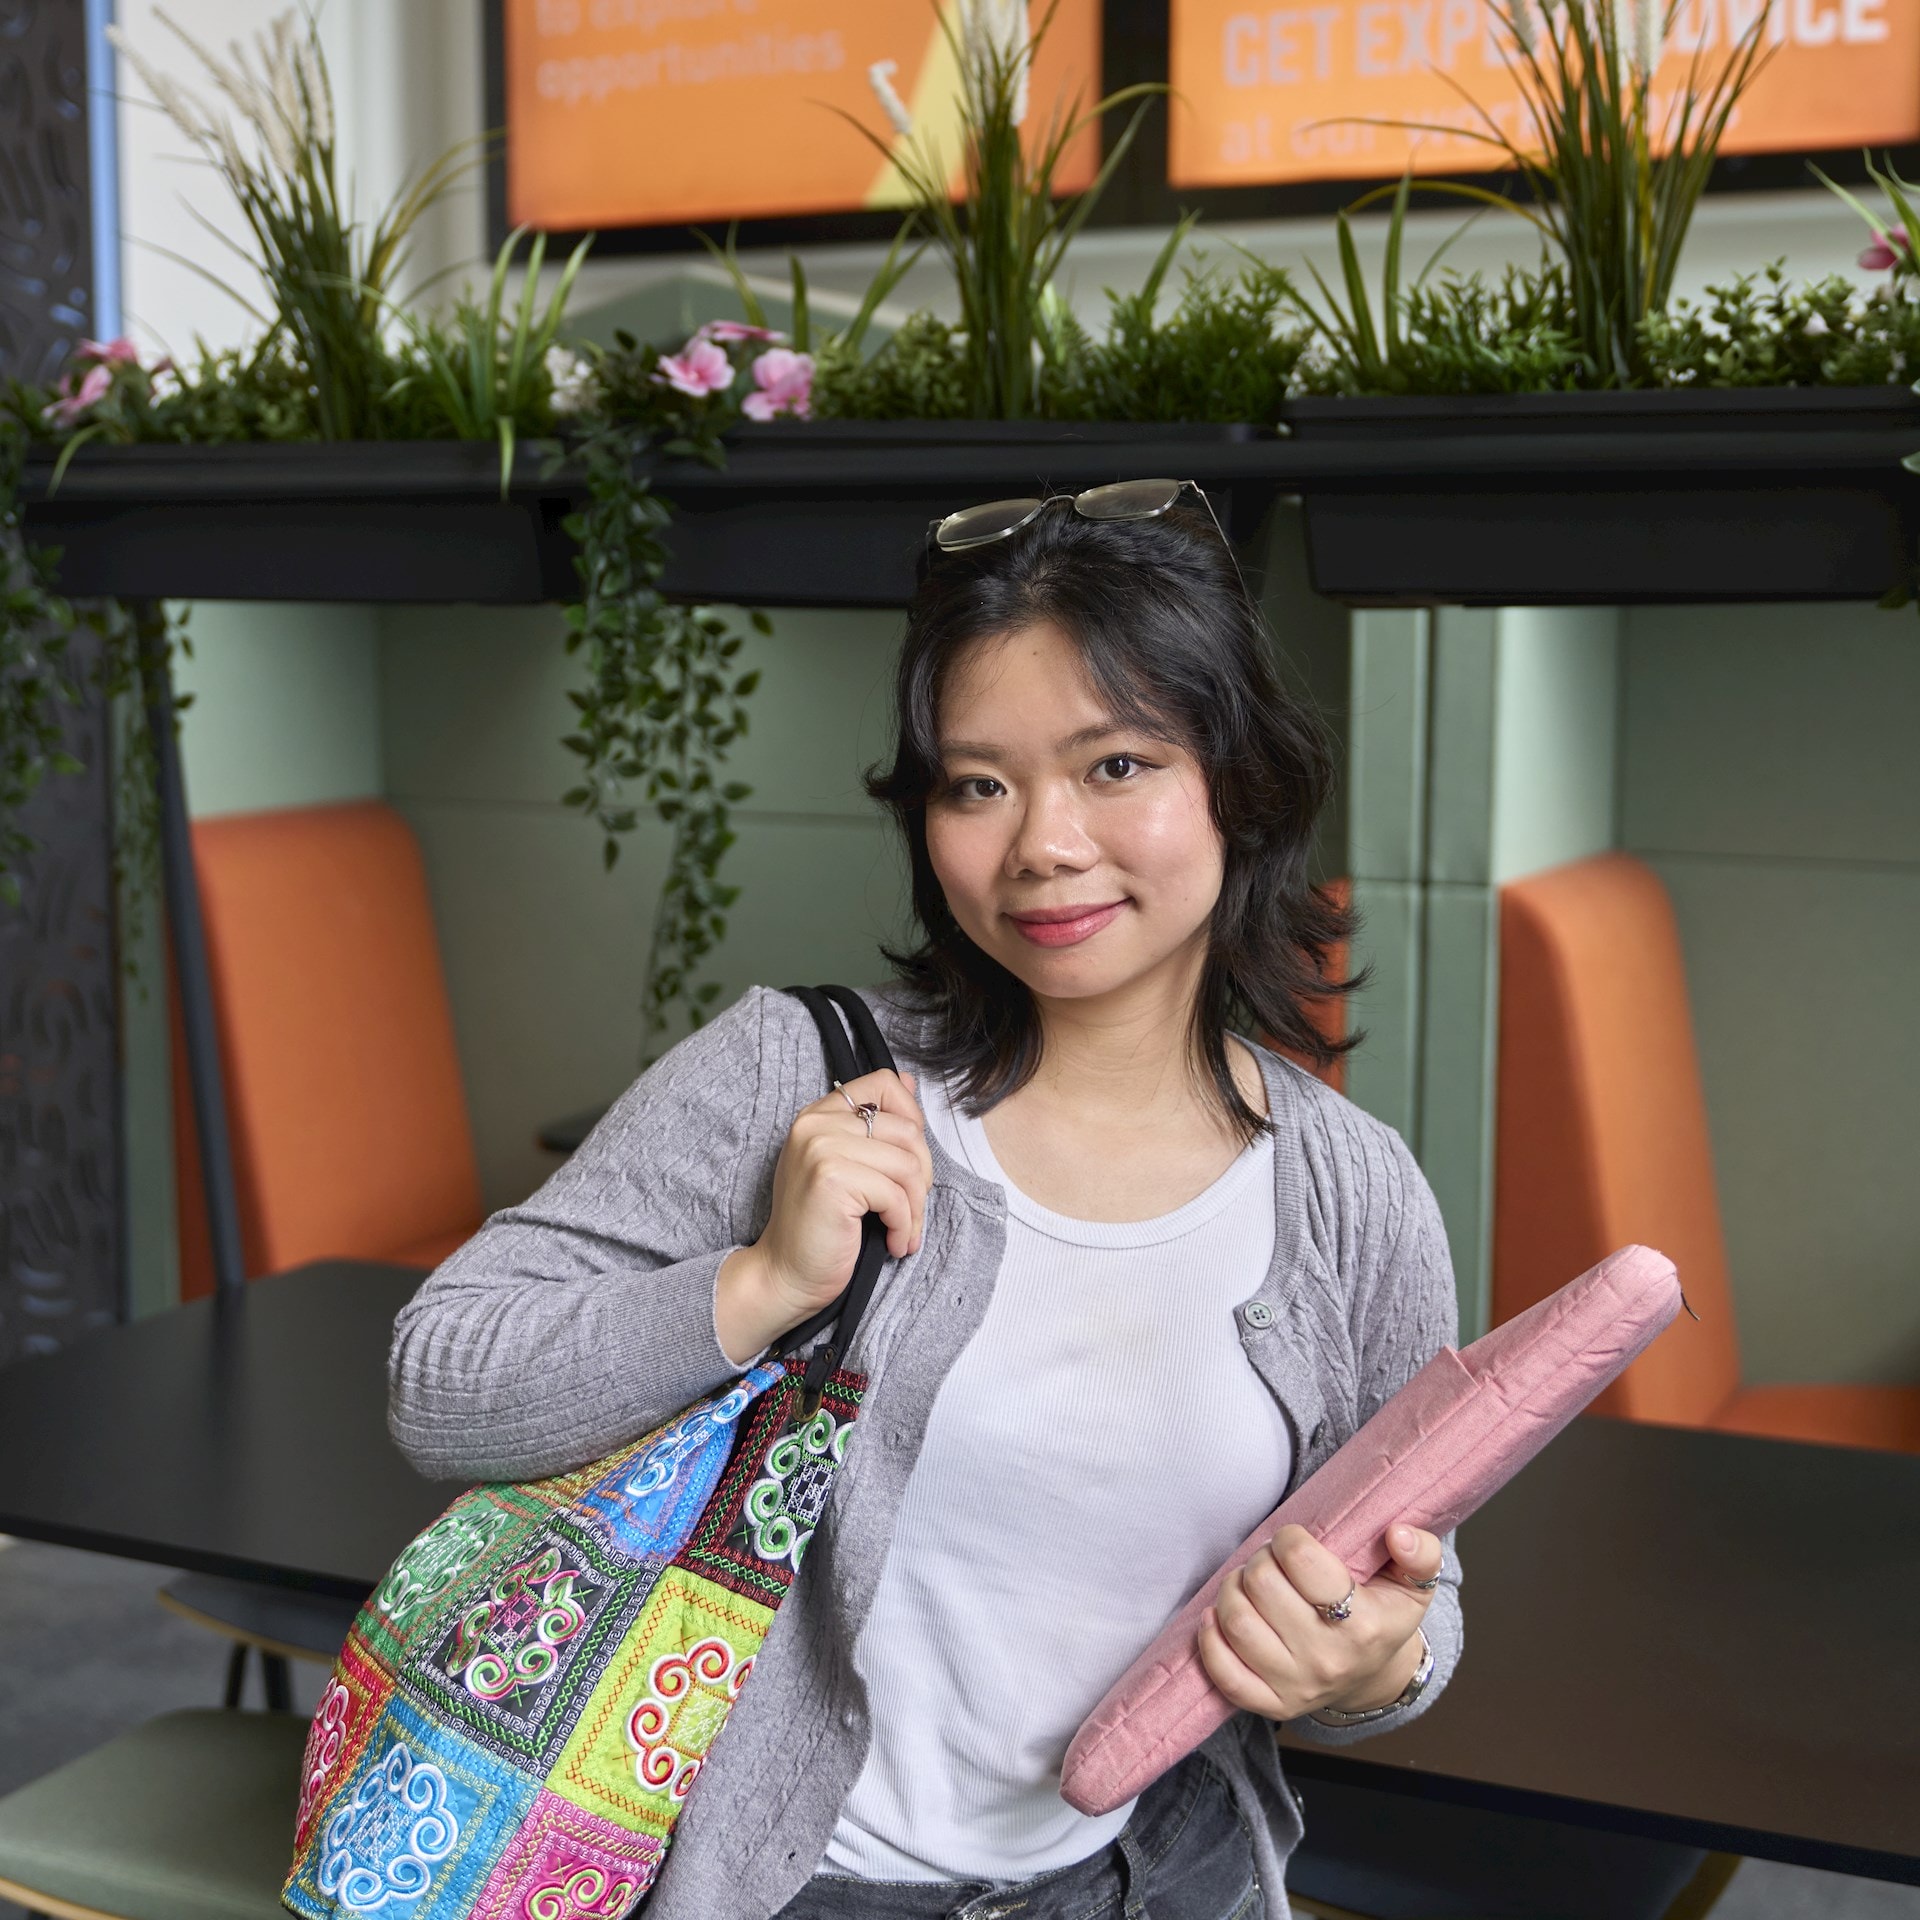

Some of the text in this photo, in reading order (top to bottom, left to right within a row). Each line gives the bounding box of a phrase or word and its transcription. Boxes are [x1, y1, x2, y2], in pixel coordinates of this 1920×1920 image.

[537, 25, 845, 106] opportunities
[1222, 8, 1340, 87] GET
[1652, 0, 1889, 54] DVICE
[1221, 112, 1271, 163] at
[1290, 110, 1386, 157] our
